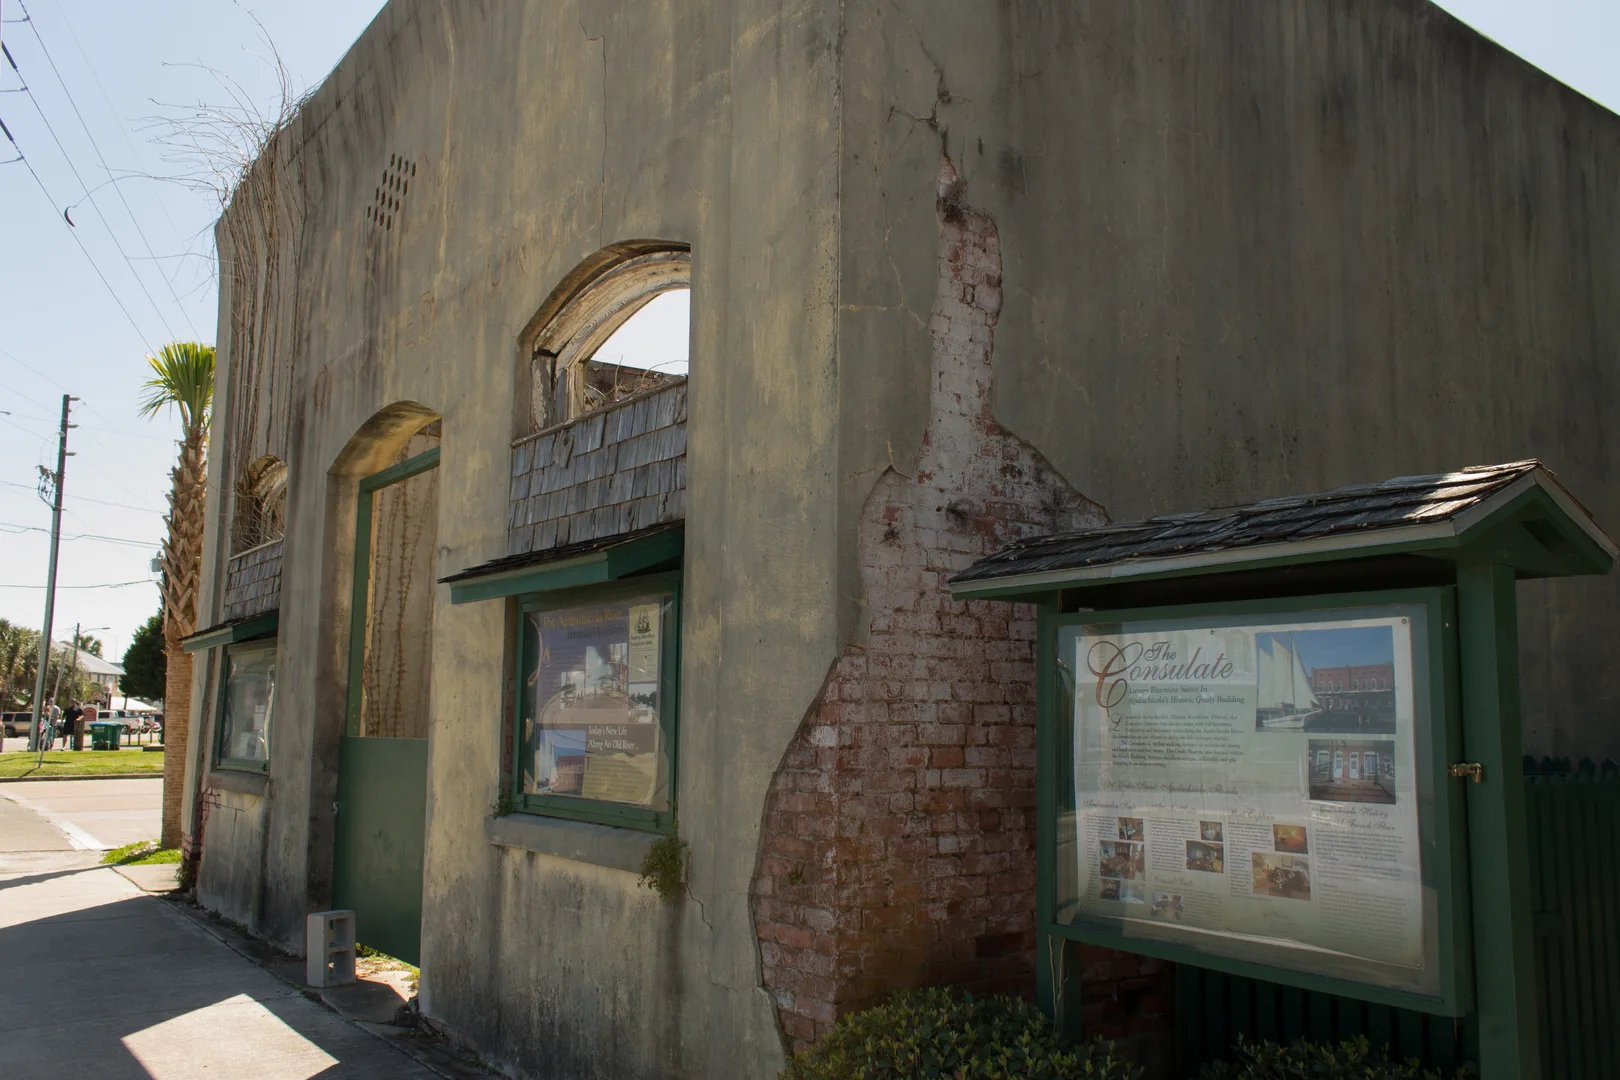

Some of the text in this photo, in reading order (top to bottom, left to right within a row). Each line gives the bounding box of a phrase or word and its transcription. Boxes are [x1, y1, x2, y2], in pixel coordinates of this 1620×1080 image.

[543, 616, 555, 629] The
[604, 609, 623, 623] River
[1144, 641, 1177, 662] The
[1087, 641, 1235, 717] Consulate
[1200, 685, 1208, 693] In
[1170, 695, 1194, 704] Historic
[1195, 695, 1214, 705] Grady
[1216, 695, 1245, 705] Building
[588, 725, 628, 736] Today's New Life
[588, 739, 603, 751] Along
[603, 739, 612, 749] An
[612, 739, 622, 749] Old
[1246, 808, 1275, 822] Captain
[1360, 806, 1388, 818] History
[1345, 818, 1372, 829] French
[1373, 820, 1396, 830] Flair
